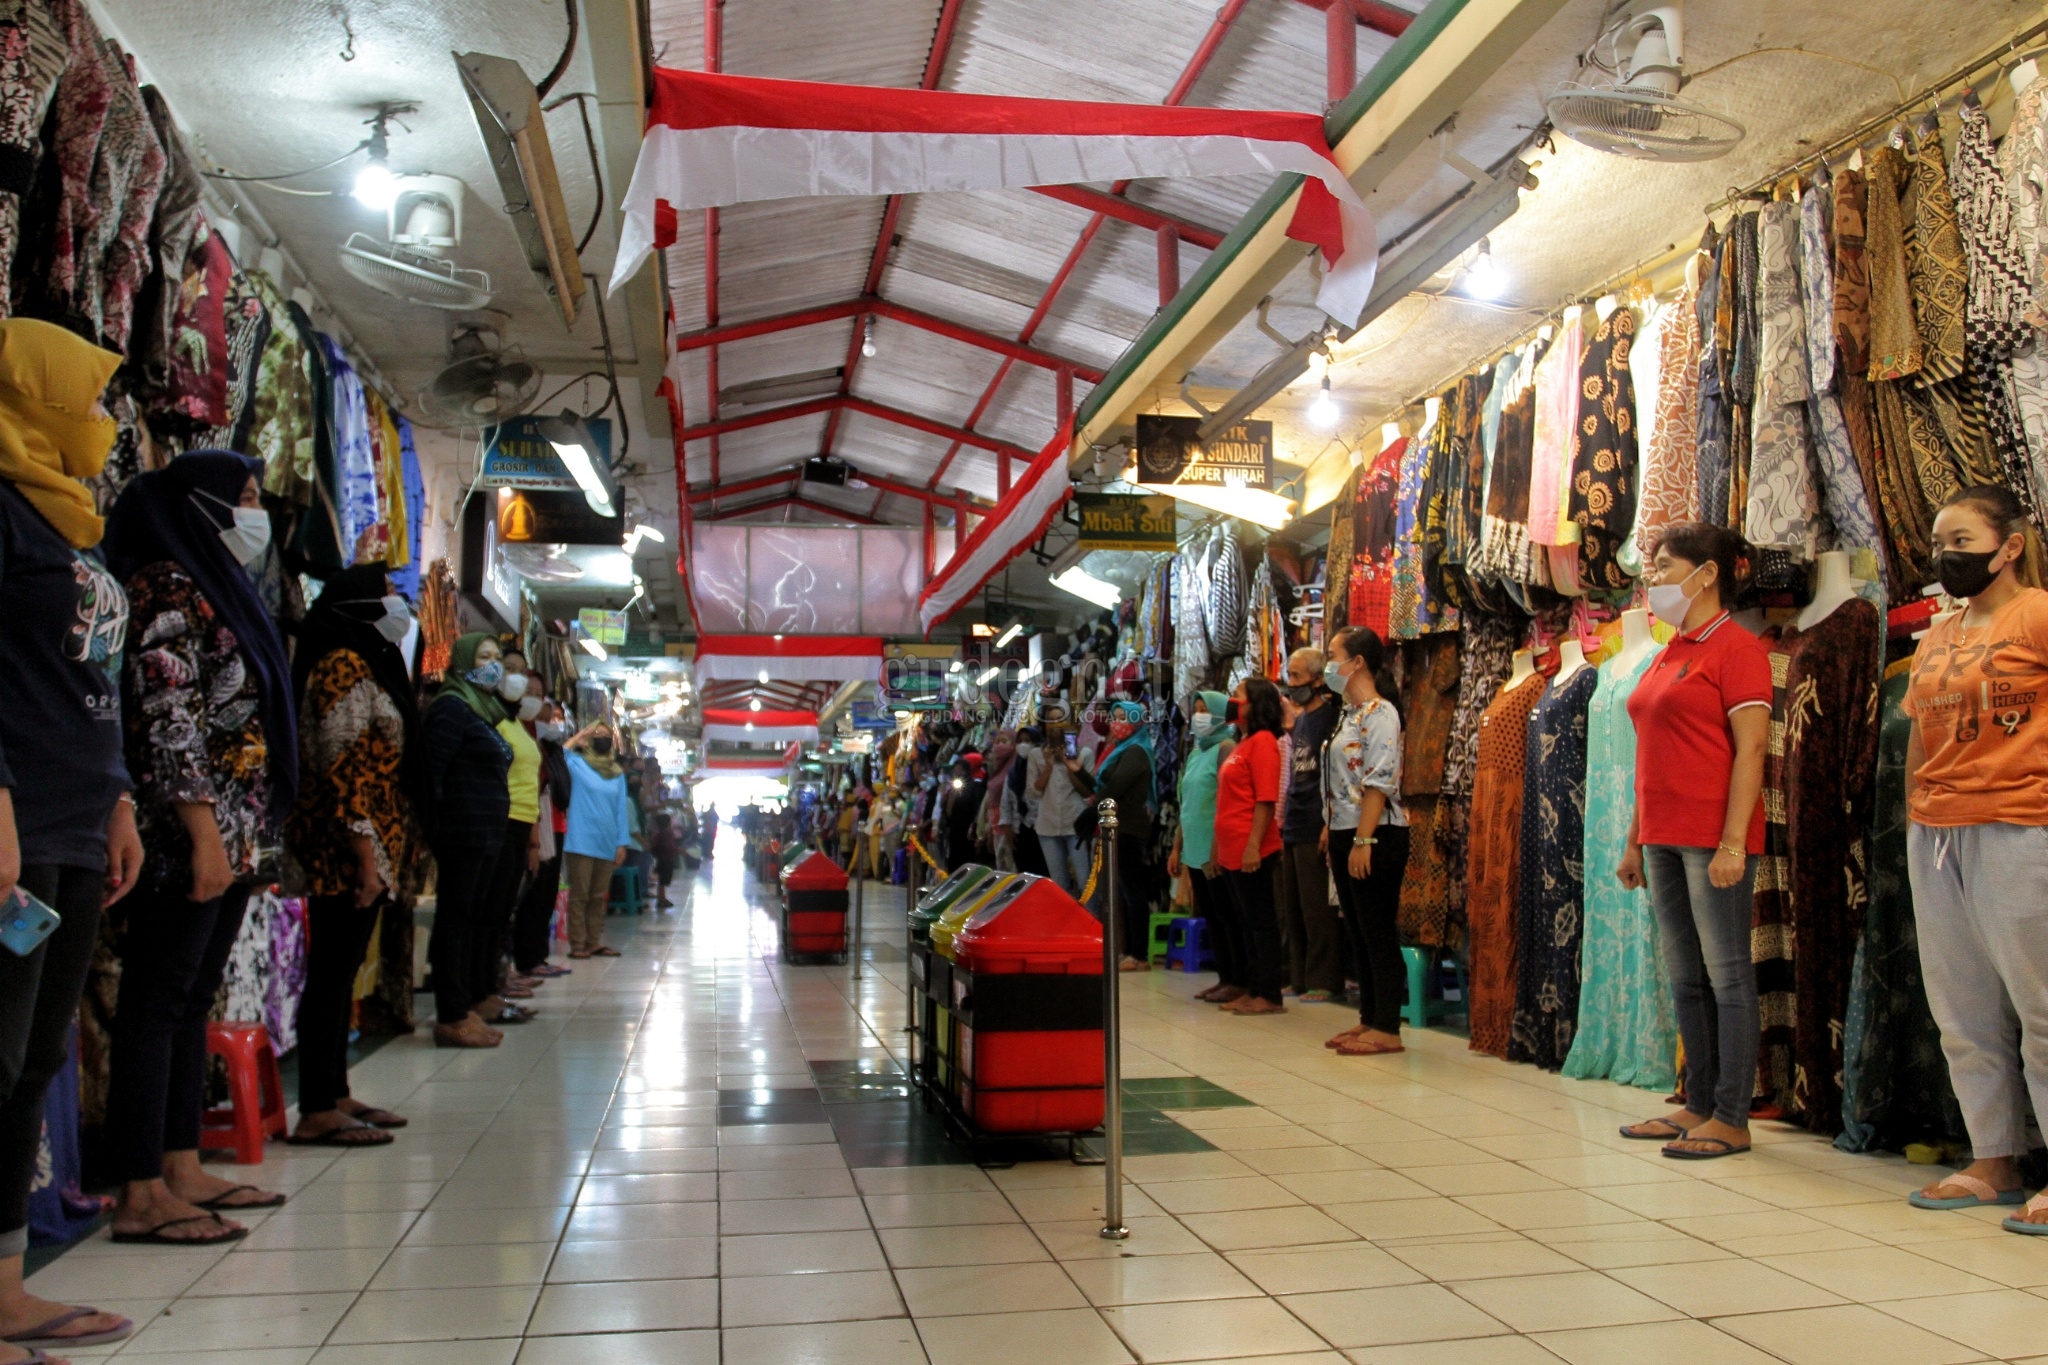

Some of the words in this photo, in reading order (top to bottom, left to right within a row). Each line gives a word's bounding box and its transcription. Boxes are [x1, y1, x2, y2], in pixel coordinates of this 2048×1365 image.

[492, 461, 529, 473] GROSIR
[535, 463, 556, 474] DAN
[1183, 466, 1221, 482] SUPER
[1224, 468, 1265, 484] MURAH
[1082, 511, 1135, 532] Mbak
[1140, 512, 1172, 533] Siti
[1992, 680, 2012, 693] to
[1994, 693, 2036, 707] HERO
[2001, 709, 2020, 734] 9
